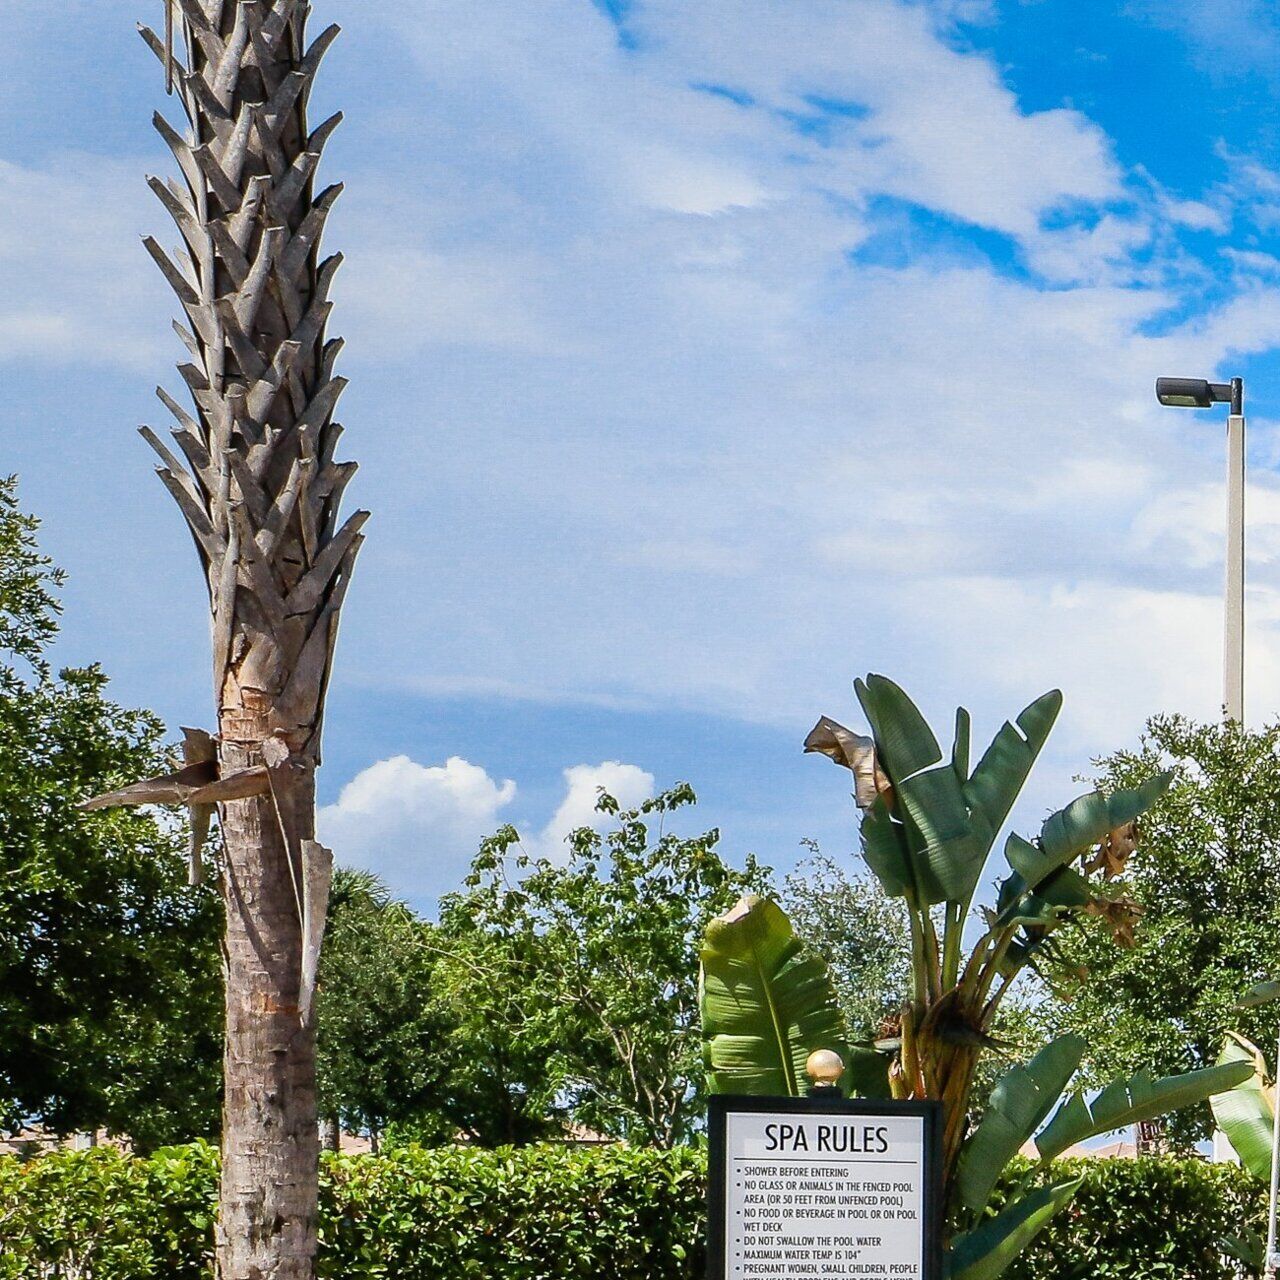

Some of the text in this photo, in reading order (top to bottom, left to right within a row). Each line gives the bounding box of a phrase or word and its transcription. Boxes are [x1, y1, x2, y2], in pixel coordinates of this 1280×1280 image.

[765, 1124, 890, 1153] SPA RULES
[744, 1166, 849, 1177] SHOWER BEFORE ENTERING
[744, 1180, 913, 1192] NO GLASS OR ANIMALS IN THE FENCED POOL
[744, 1194, 903, 1205] AREA (OR 50 FEET FROM UNFENCED POOL)
[744, 1208, 917, 1219] NO FOOD OR BEVERAGE IN POOL OR ON POOL
[743, 1222, 783, 1232] WET DECK
[744, 1236, 882, 1246] DO NOT SWALLOW THE POOL WATER
[743, 1250, 782, 1259] MAXIMUM
[784, 1250, 810, 1259] WATER
[812, 1250, 833, 1259] TEMP
[835, 1250, 842, 1259] IS
[743, 1264, 917, 1274] PREGNANT WOMEN, SMALL CHILDREN, PEOPLE
